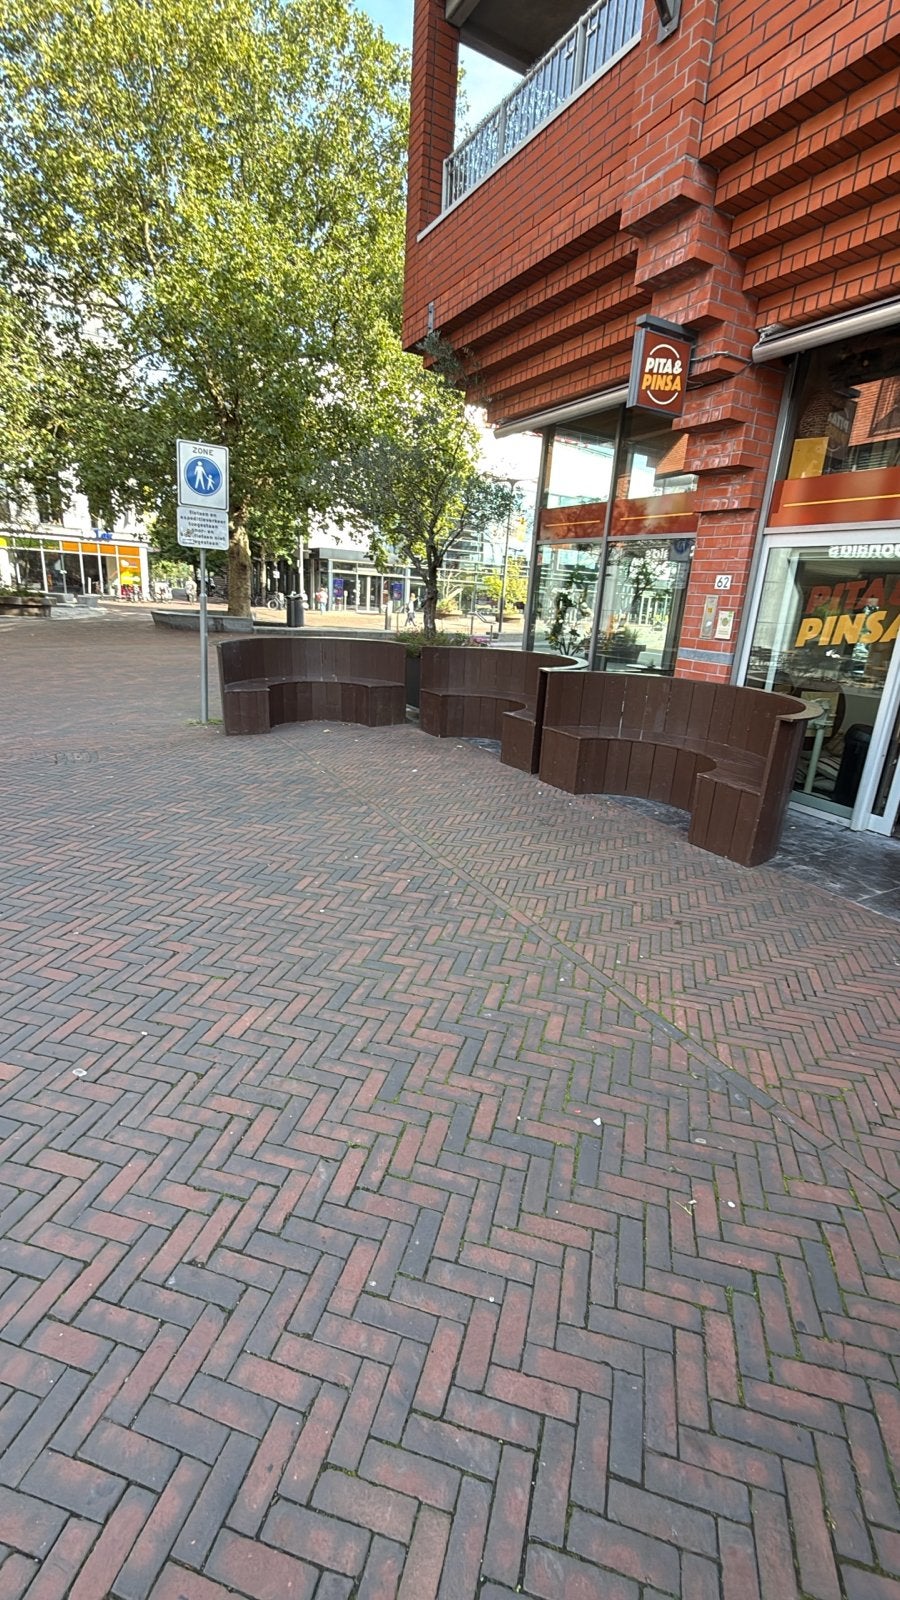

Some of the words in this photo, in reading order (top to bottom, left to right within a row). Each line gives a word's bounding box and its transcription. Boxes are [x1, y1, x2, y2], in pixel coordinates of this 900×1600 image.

[645, 357, 683, 375] PITA&
[641, 373, 682, 392] PINSA
[192, 446, 214, 456] ZONE
[716, 576, 730, 588] 62
